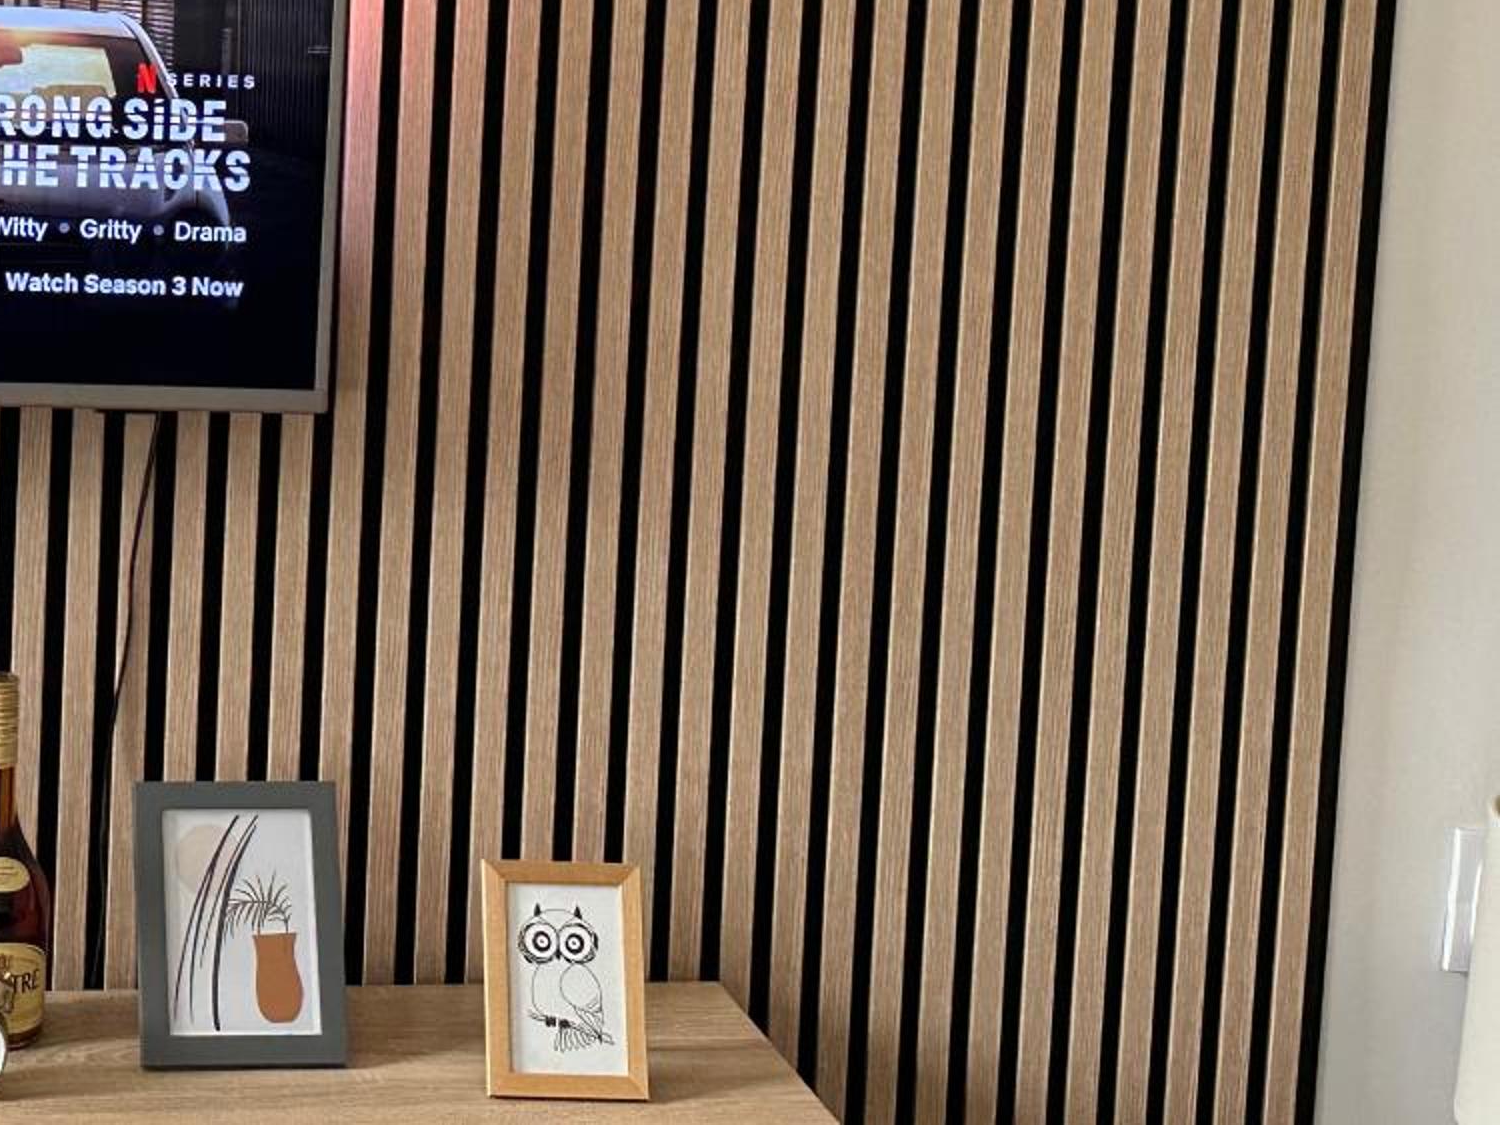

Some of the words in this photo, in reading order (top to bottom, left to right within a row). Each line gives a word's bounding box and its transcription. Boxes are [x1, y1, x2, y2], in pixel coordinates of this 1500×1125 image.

[136, 62, 156, 93] N
[167, 72, 256, 89] SERIES
[69, 145, 251, 192] TRACKS
[79, 218, 142, 245] Gritty
[174, 221, 247, 242] Drama
[5, 272, 79, 294] Watch
[83, 274, 167, 295] Season
[171, 276, 187, 296] 3
[192, 277, 244, 297] Now
